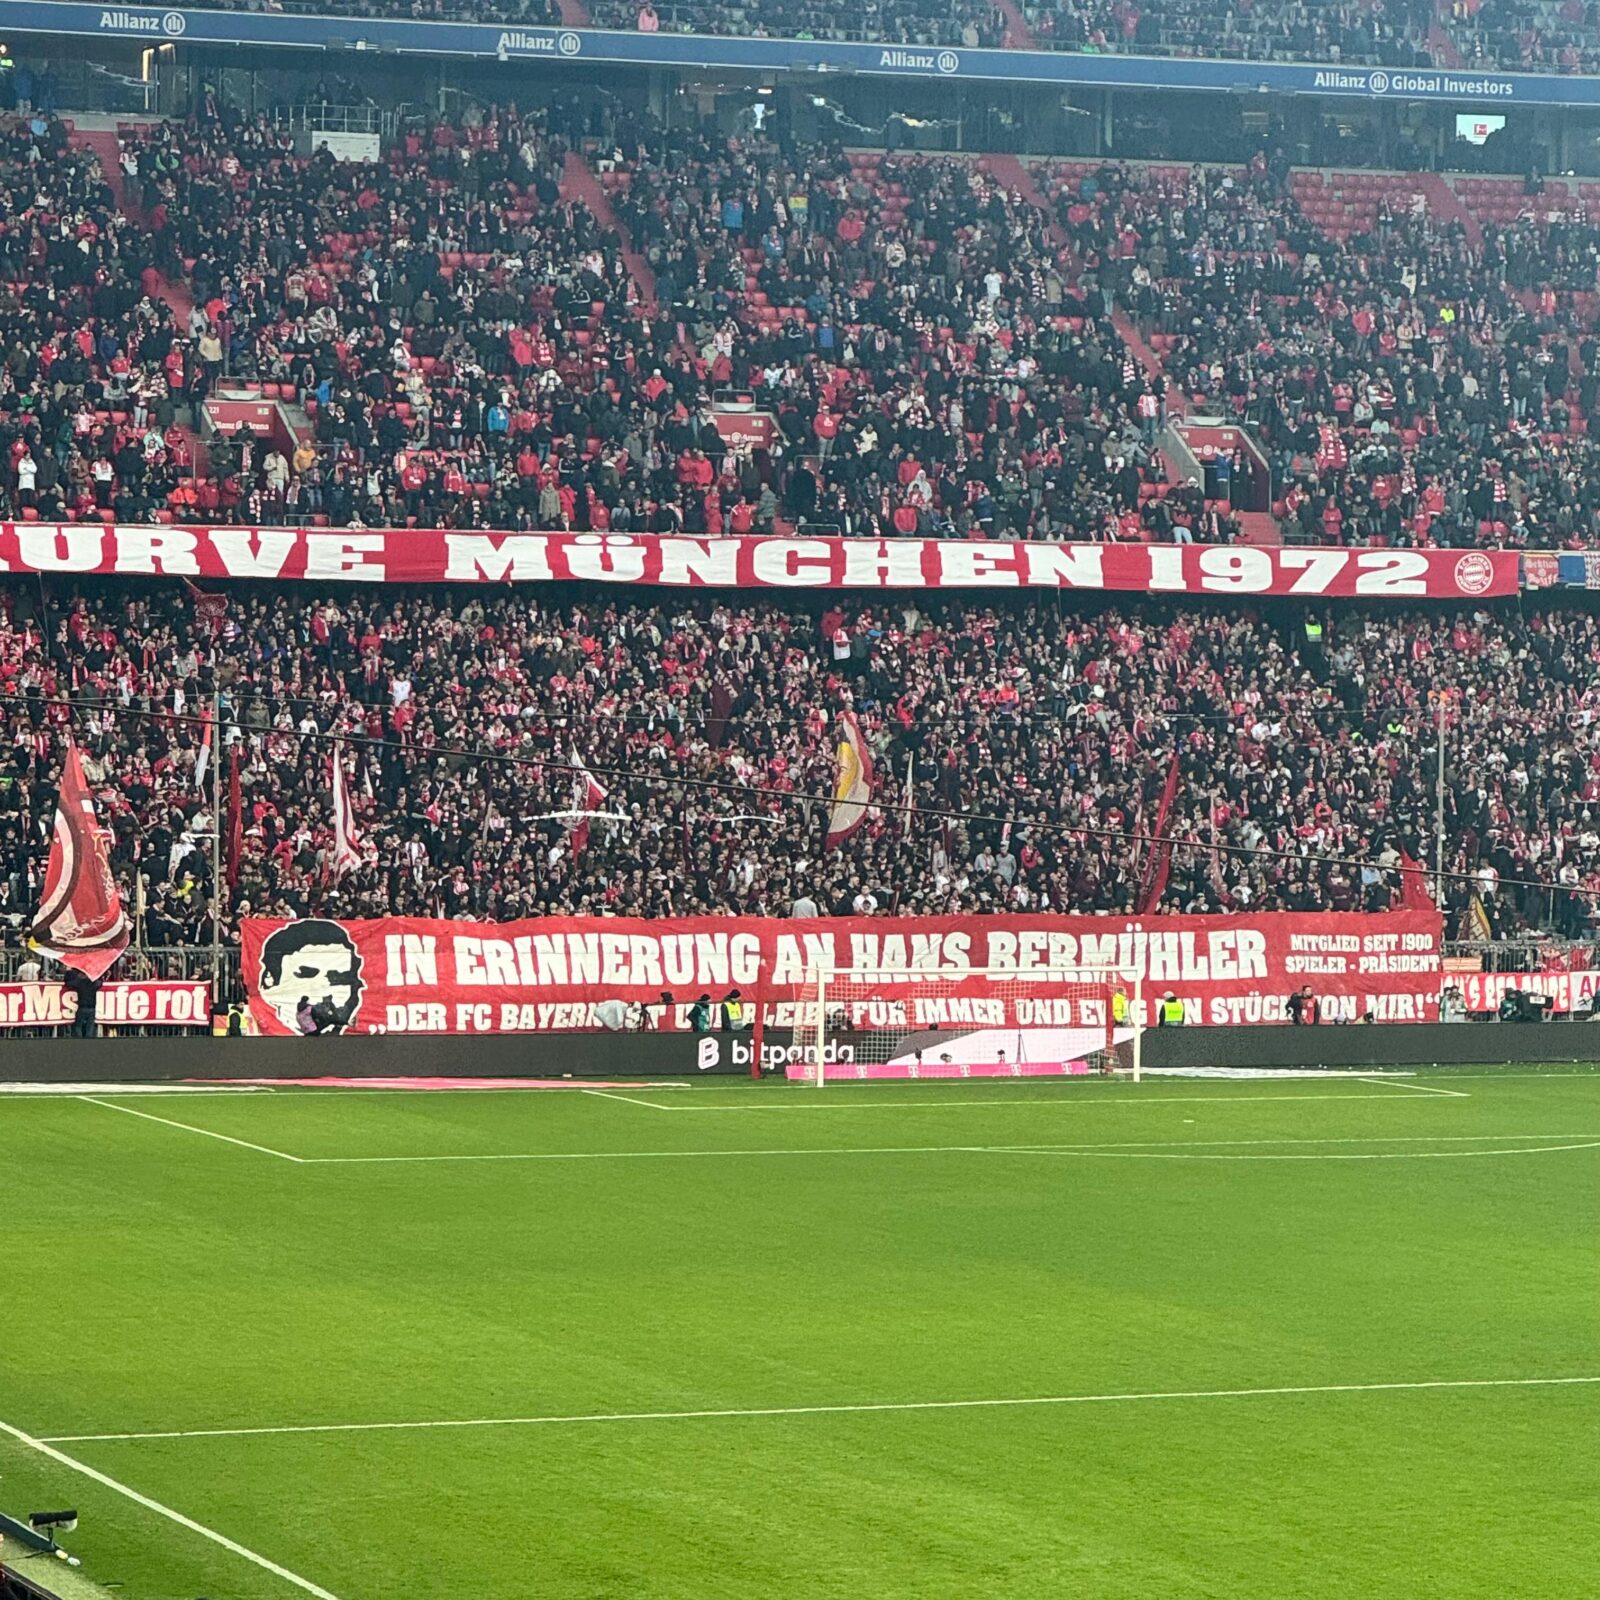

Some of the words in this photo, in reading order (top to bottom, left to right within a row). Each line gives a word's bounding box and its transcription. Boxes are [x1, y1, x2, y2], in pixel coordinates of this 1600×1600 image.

[100, 11, 160, 31] Allianz
[500, 32, 554, 51] Allianz
[880, 50, 934, 69] Allianz
[1314, 72, 1366, 89] Allianz
[1392, 75, 1440, 93] Global
[1444, 78, 1513, 95] Investors
[444, 534, 1104, 588] MÜNCHEN
[1147, 547, 1429, 596] 1972
[385, 934, 437, 986] IN
[454, 933, 760, 986] ERINNERUNG
[772, 932, 836, 985] AN
[850, 932, 971, 985] HANS
[986, 922, 1268, 983] BERMÜHLER
[1290, 934, 1360, 953] MITGLIED
[1364, 934, 1399, 952] SEIT
[1402, 933, 1433, 951] 1900
[1285, 955, 1346, 974] SPIELER
[1359, 952, 1439, 974] PRÄSIDENT
[155, 987, 208, 1021] rot
[456, 1003, 492, 1032] FC
[853, 996, 907, 1026] FÜR
[916, 997, 1005, 1025] IMMER
[1015, 998, 1071, 1025] UND
[1312, 994, 1357, 1021] ON
[731, 1039, 854, 1070] bitpanda
